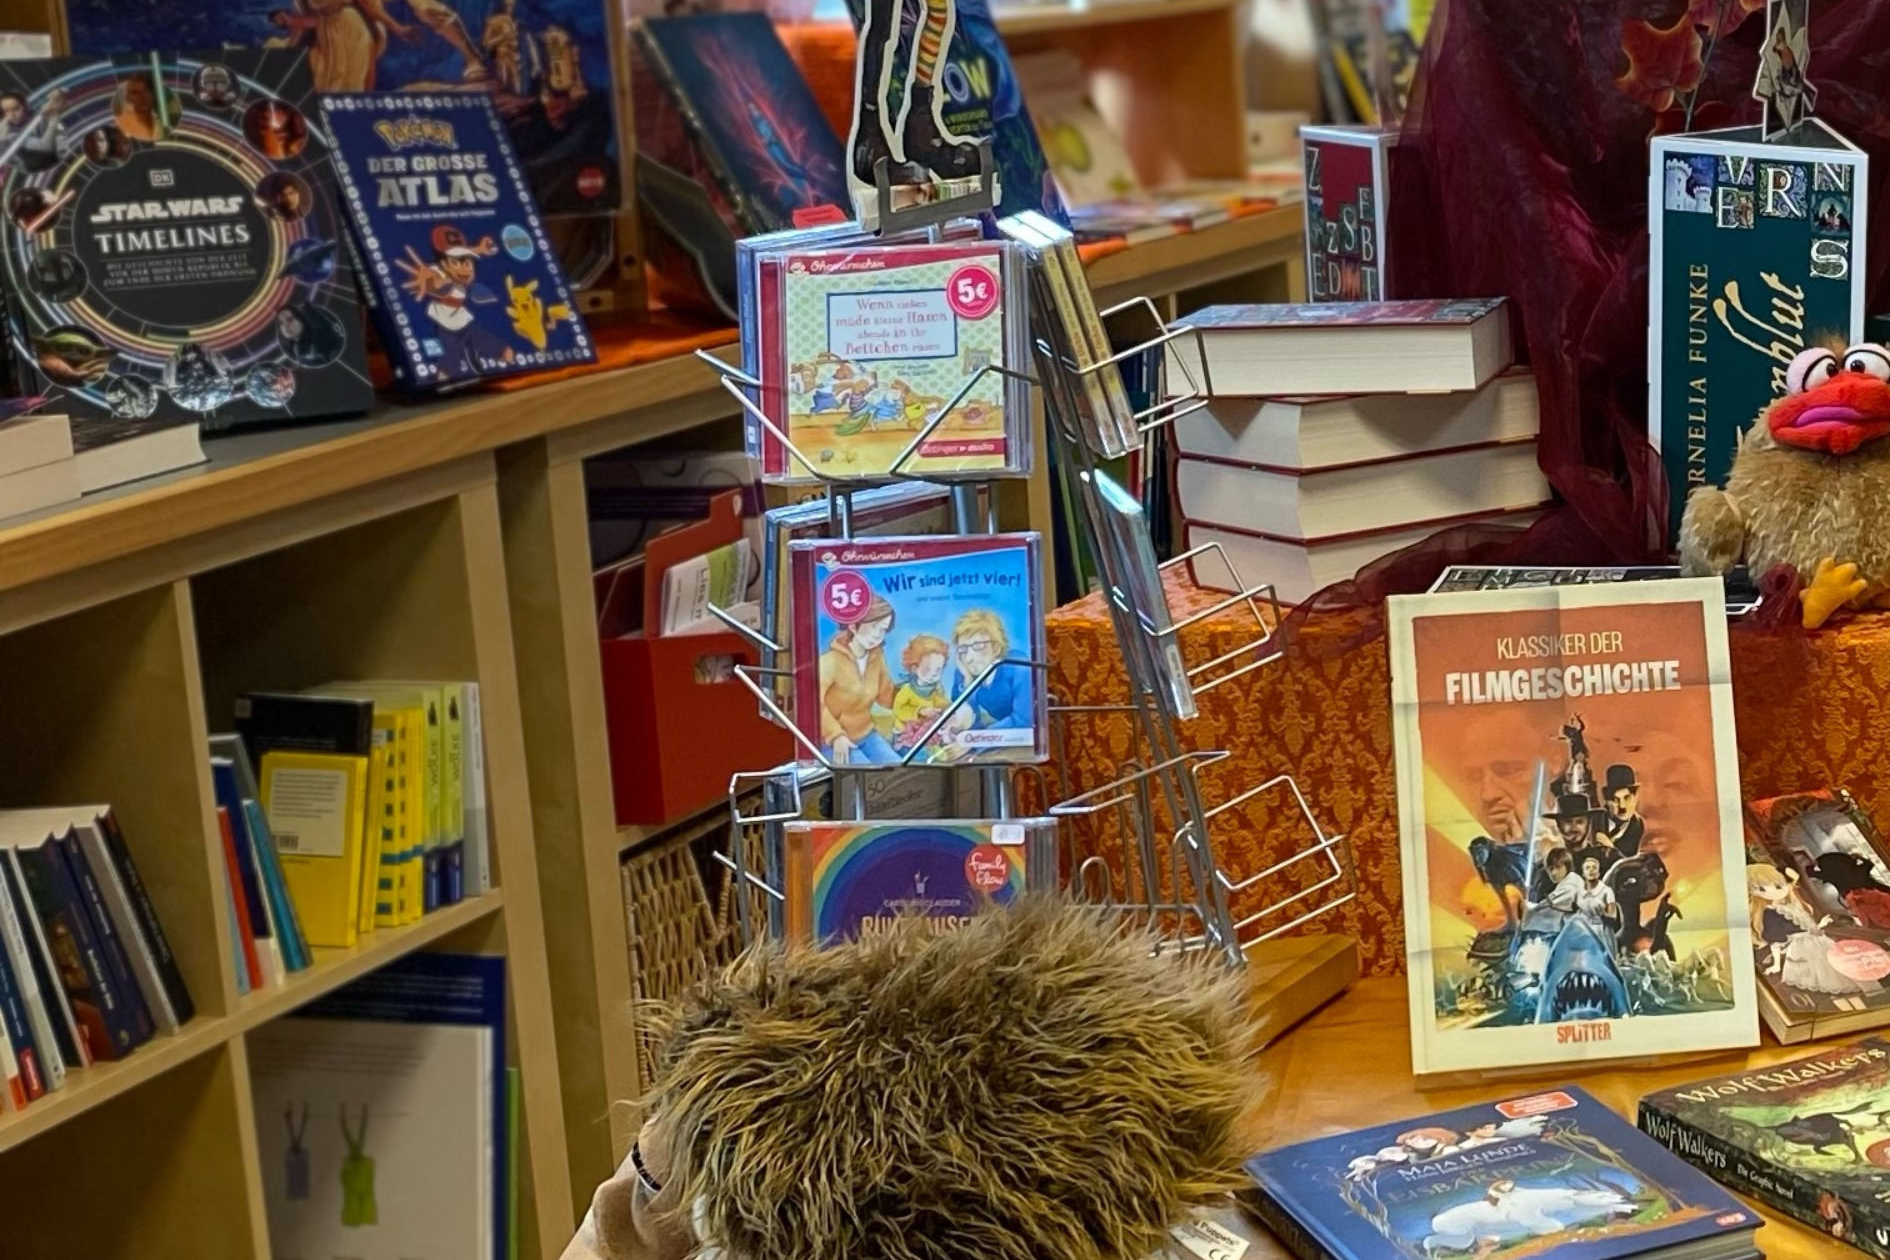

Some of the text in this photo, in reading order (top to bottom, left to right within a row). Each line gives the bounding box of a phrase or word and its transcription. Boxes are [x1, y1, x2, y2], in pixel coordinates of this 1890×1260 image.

[367, 154, 488, 173] DER GROSSE
[376, 172, 498, 208] ATLAS
[90, 196, 243, 223] STAR WARS
[94, 224, 251, 255] TIMELINES
[856, 298, 895, 310] Wenn
[956, 277, 989, 304] 5€
[844, 339, 909, 356] Bettchen
[1687, 263, 1709, 495] RNELIA FUNKE
[882, 570, 1022, 595] Wir sind jetzt vier!
[831, 583, 863, 610] 5€
[1496, 631, 1624, 661] KLASSIKER DER
[1445, 659, 1682, 706] FILMGESCHICHTE
